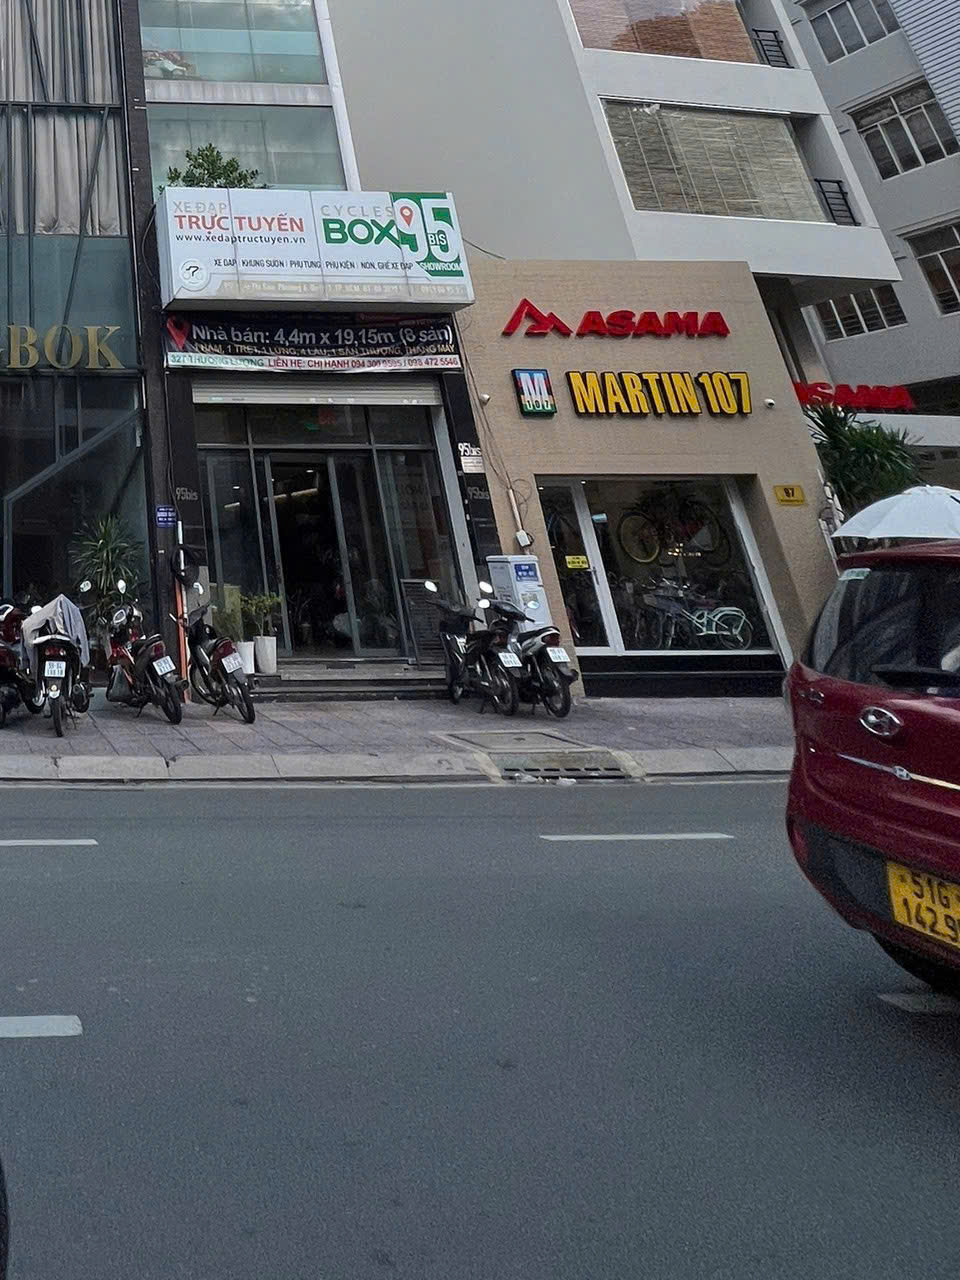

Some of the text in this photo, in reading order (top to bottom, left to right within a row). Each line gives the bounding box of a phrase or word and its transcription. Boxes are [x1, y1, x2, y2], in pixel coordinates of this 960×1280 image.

[173, 201, 192, 213] XE
[321, 205, 394, 217] CYCLES
[234, 213, 305, 232] TUYẾN
[393, 198, 460, 262] 95
[175, 234, 306, 245] www.xedaptructuyen.vn
[322, 218, 401, 246] BOX
[428, 233, 447, 246] BIS
[419, 262, 463, 271] SHOWROOM
[576, 310, 730, 337] ASAMA
[191, 325, 228, 340] Nhà
[231, 327, 270, 343] bán:
[274, 328, 315, 346] 4,4m
[320, 333, 330, 344] x
[335, 329, 395, 346] 19,15m
[424, 357, 439, 366] 472
[566, 371, 752, 415] MARTIN 107
